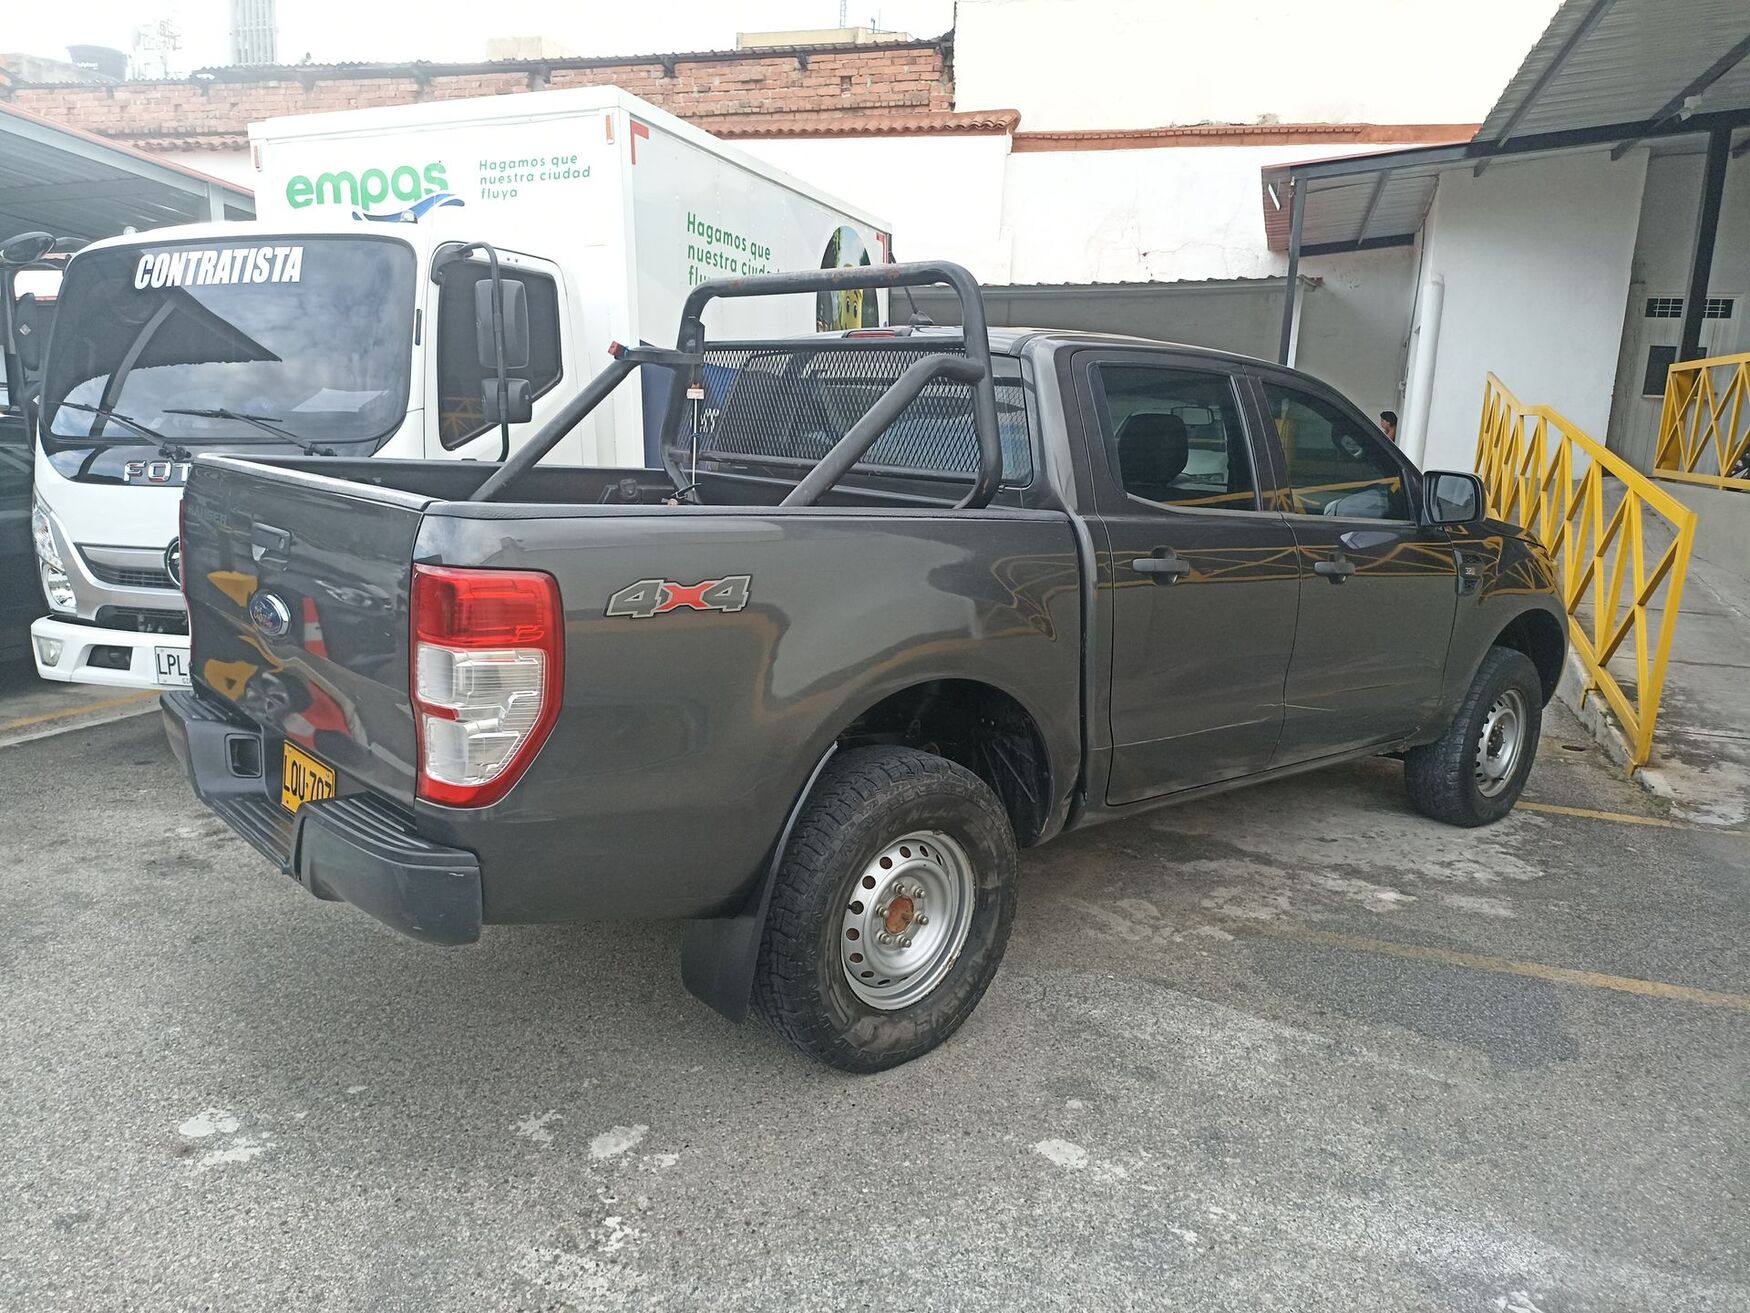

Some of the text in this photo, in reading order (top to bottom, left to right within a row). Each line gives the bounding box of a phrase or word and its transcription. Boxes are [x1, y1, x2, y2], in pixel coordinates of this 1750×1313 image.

[479, 155, 578, 173] Hagamos que
[480, 166, 591, 185] nuestra ciudad
[286, 163, 448, 211] empas
[481, 187, 518, 200] fluya
[687, 212, 771, 261] Hagamos que
[134, 246, 304, 290] CONTRATISTA
[687, 244, 780, 276] nuestra ciud
[157, 653, 188, 676] LPL
